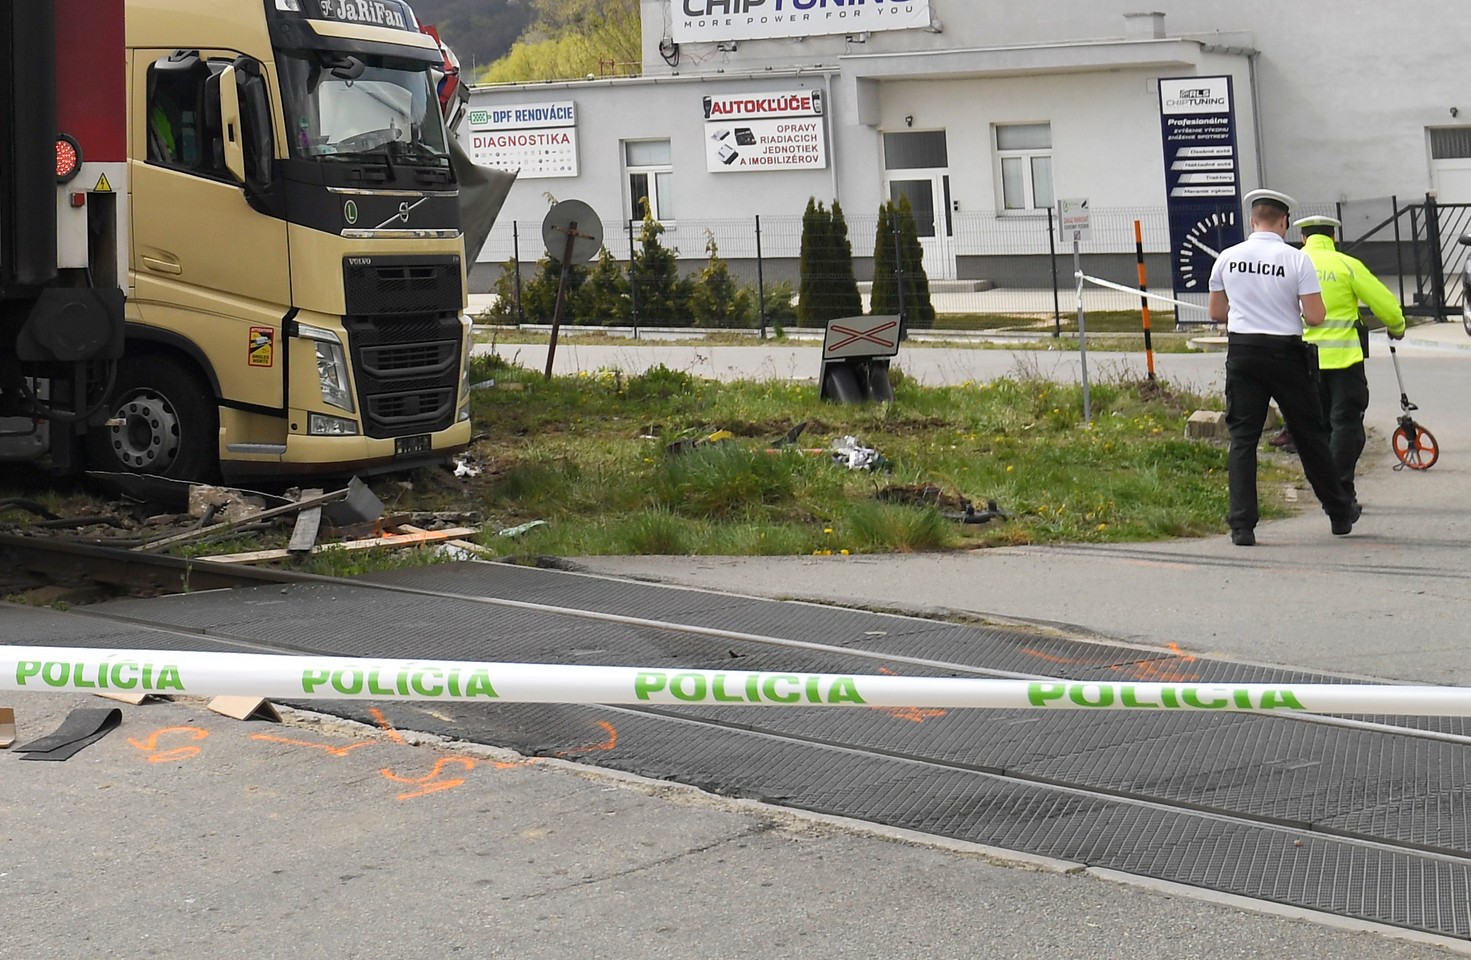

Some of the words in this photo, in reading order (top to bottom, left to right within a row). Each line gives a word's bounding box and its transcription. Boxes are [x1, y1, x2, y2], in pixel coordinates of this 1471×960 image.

[683, 19, 732, 29] MORE
[746, 13, 810, 25] POWER
[825, 9, 861, 20] FOR
[877, 5, 914, 16] YOU
[711, 94, 811, 115] AUTOKĽÚČE
[492, 110, 512, 123] DPF
[515, 104, 573, 122] RENOVÁCIE
[776, 123, 817, 133] OPRAVY
[473, 133, 570, 149] DIAGNOSTIKA
[760, 134, 818, 144] RIADIACICH
[762, 144, 819, 154] JEDNOTIEK
[739, 157, 747, 166] A
[748, 152, 819, 165] IMOBILIZÉROV
[1229, 261, 1285, 278] POLÍCIA
